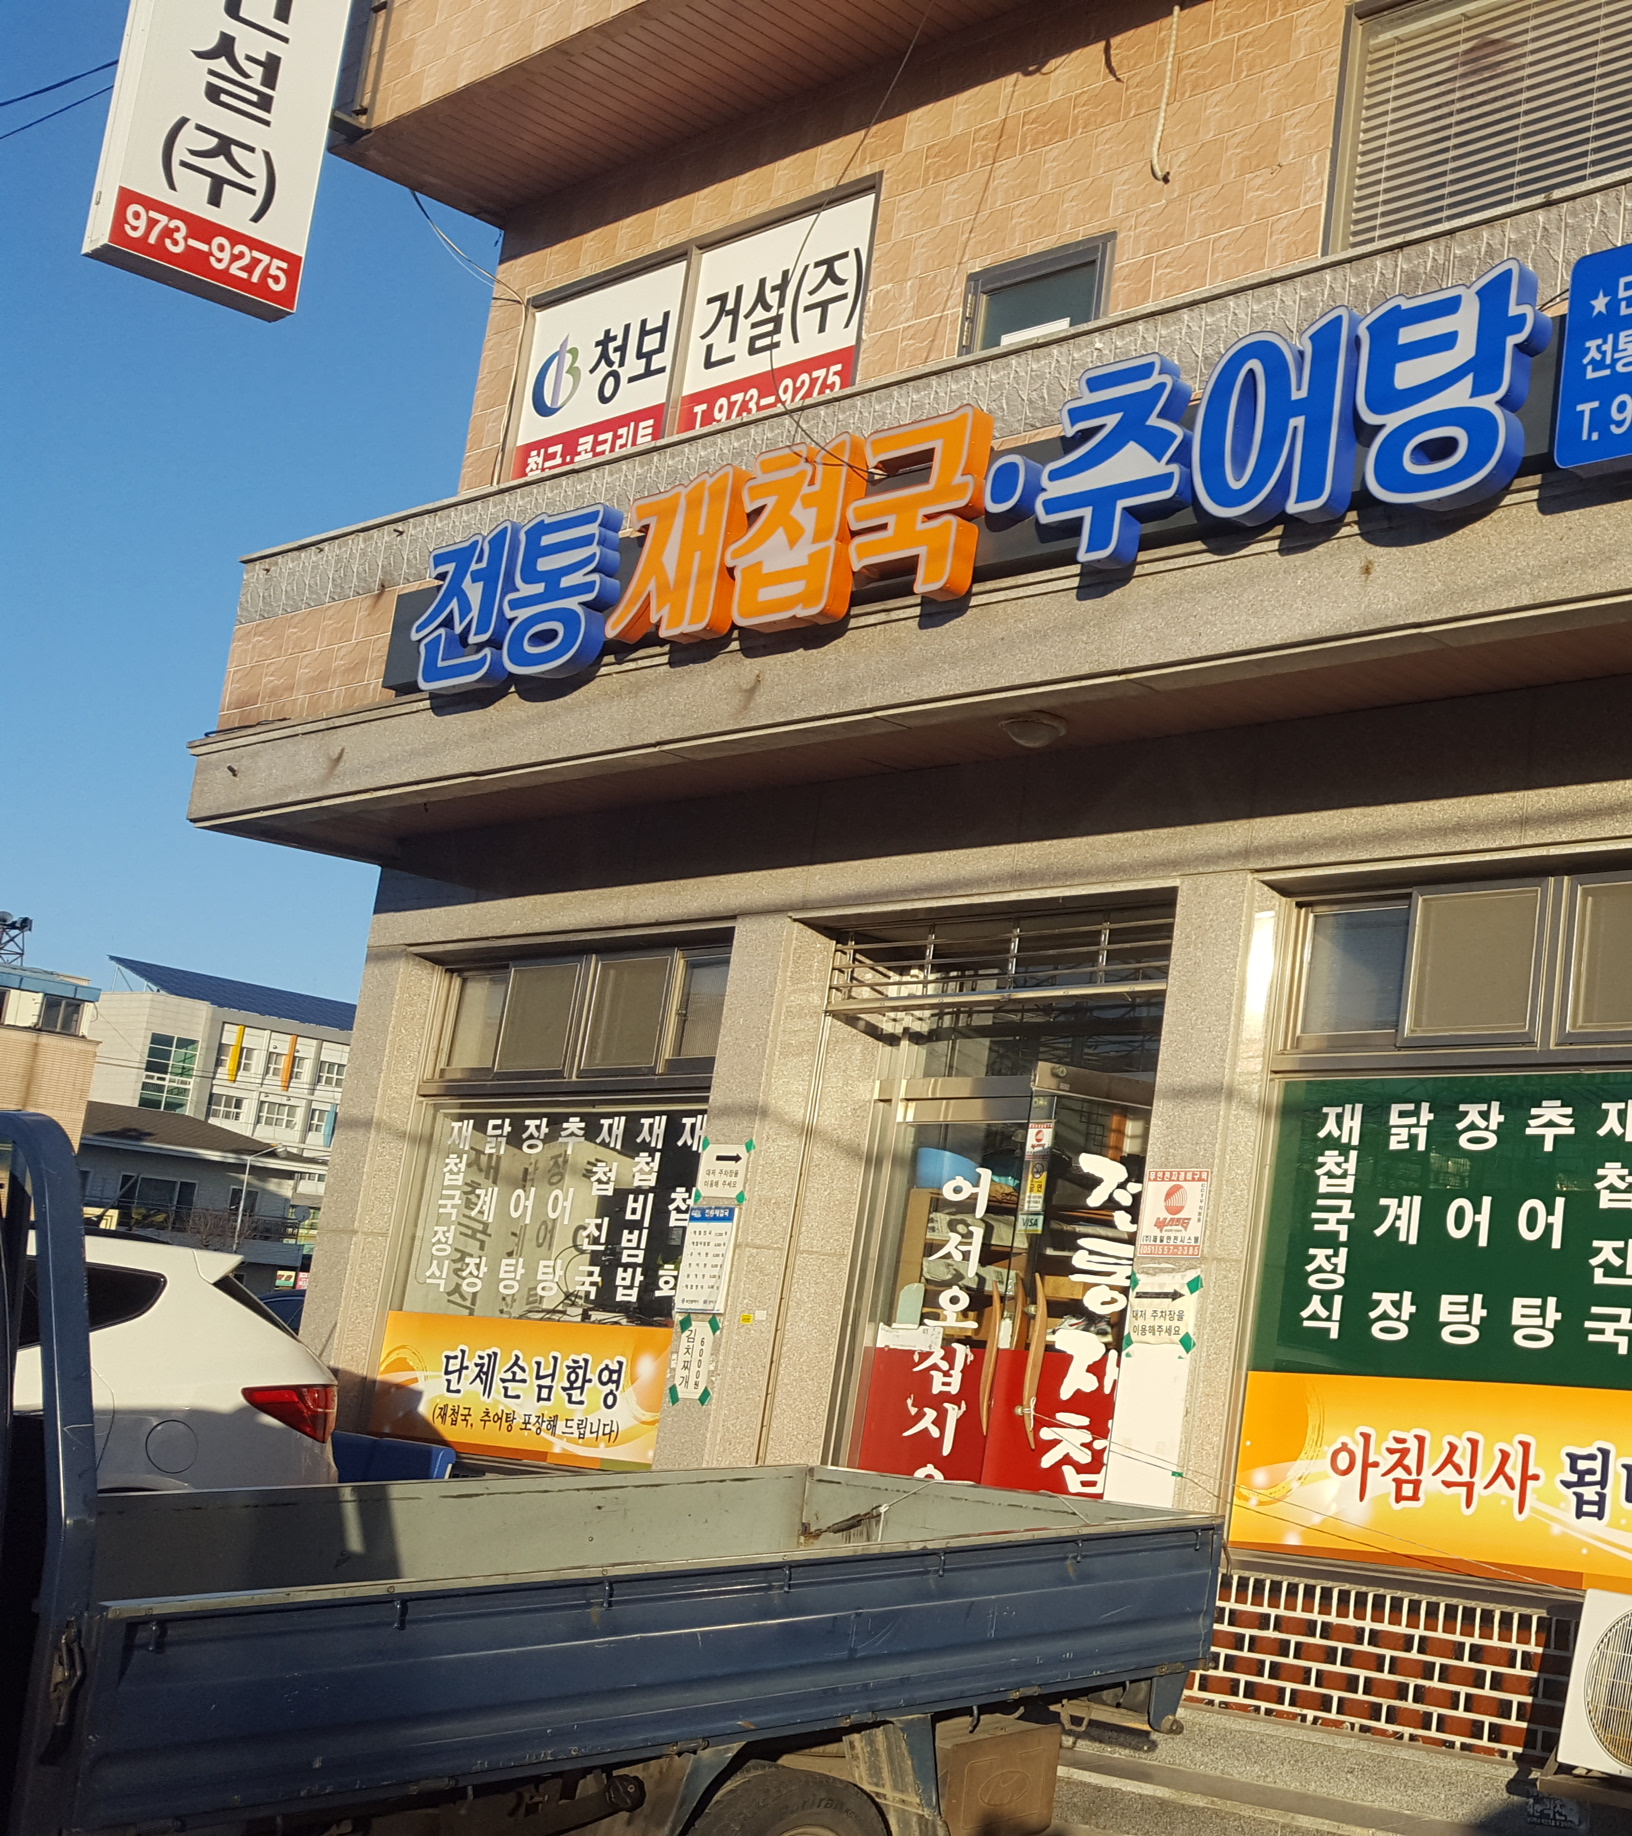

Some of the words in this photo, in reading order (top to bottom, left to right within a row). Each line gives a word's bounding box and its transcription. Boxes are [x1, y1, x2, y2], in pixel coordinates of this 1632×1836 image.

[124, 203, 288, 291] 973-9275
[588, 310, 671, 405] 청보
[699, 247, 863, 370] 건설(주)
[410, 501, 618, 692] 전통
[1021, 1218, 1039, 1227] VISA
[1300, 1103, 1363, 1339] 재첩국정식
[1368, 1102, 1434, 1341] 닭계장
[1438, 1101, 1504, 1345] 장어탕
[1511, 1099, 1575, 1348] 추어탕
[1150, 1309, 1185, 1322] 주차장을
[442, 1346, 625, 1411] 단체손님환영
[479, 1407, 517, 1433] 추어탕
[519, 1412, 559, 1437] 포장해
[561, 1417, 620, 1444] 드립니다)
[1330, 1431, 1540, 1516] 아침식사
